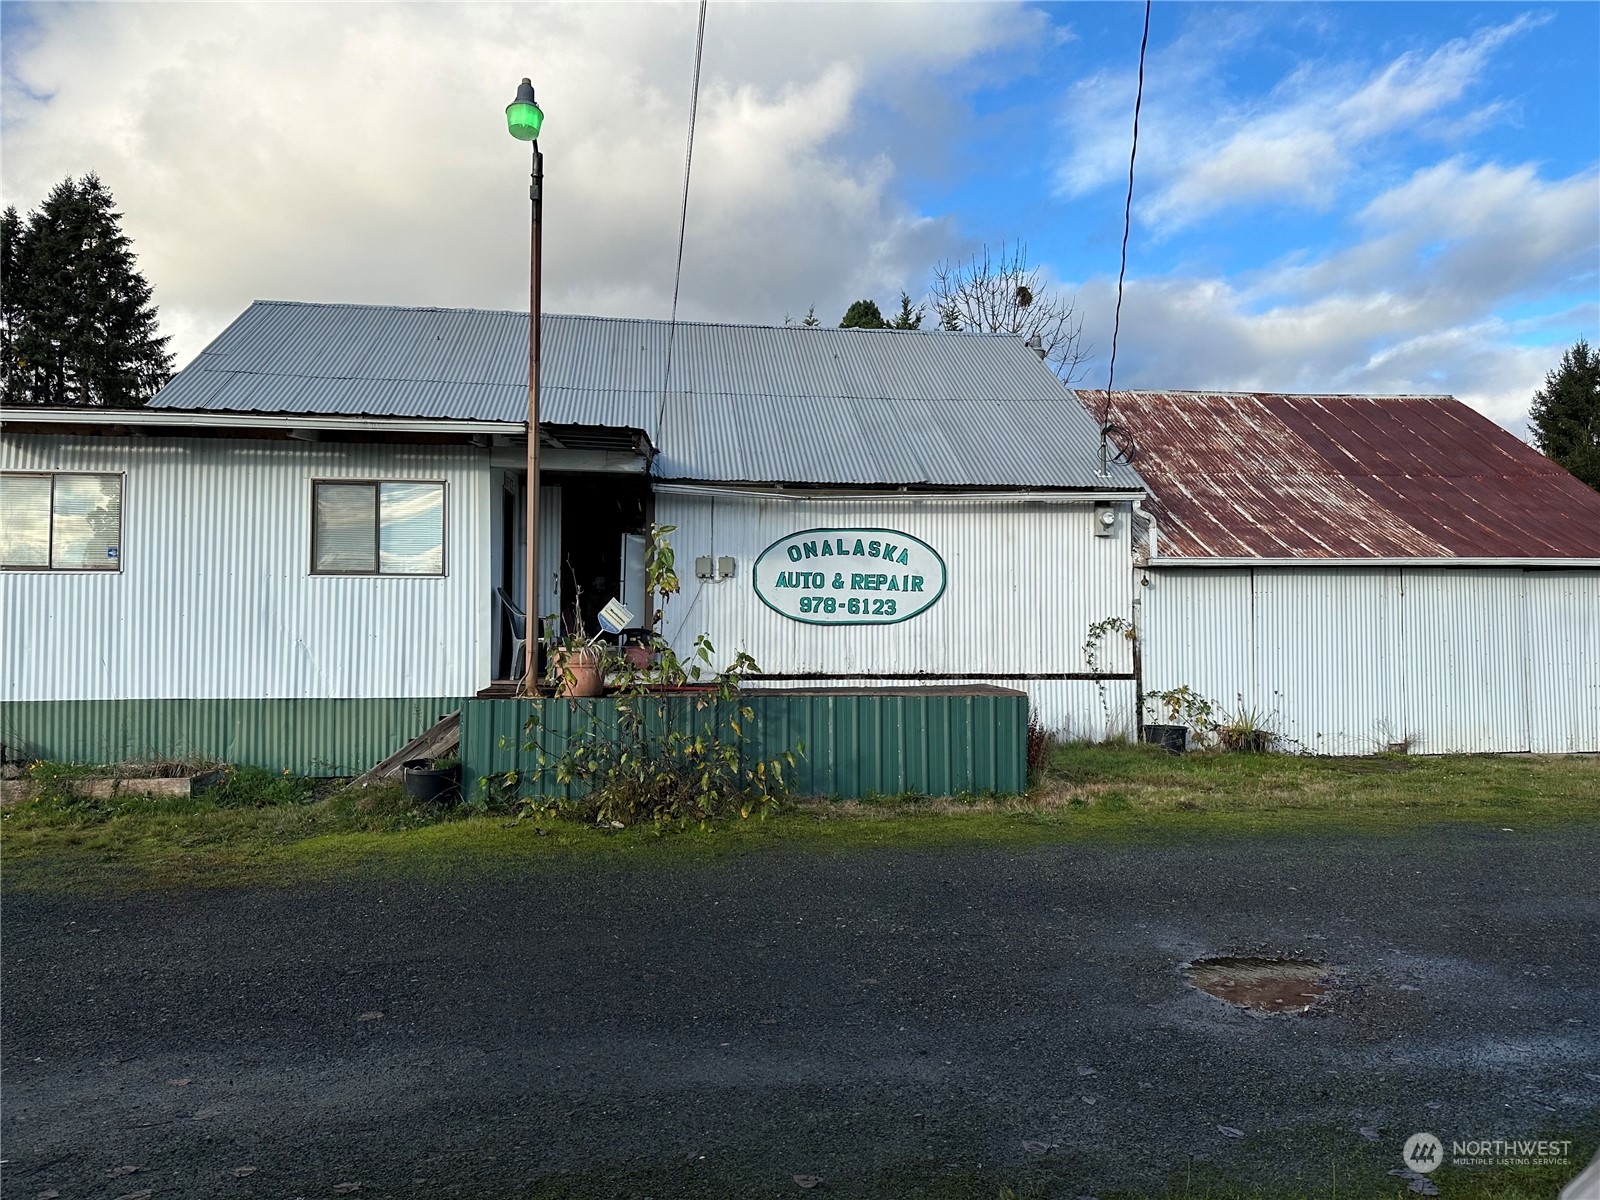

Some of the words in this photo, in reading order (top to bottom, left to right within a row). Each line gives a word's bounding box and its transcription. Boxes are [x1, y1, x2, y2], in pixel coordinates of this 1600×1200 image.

[786, 538, 909, 566] ONALASKA
[775, 571, 826, 589] AUTO
[831, 572, 845, 589] &
[850, 573, 924, 592] REPAIR
[799, 596, 897, 615] 978-6123
